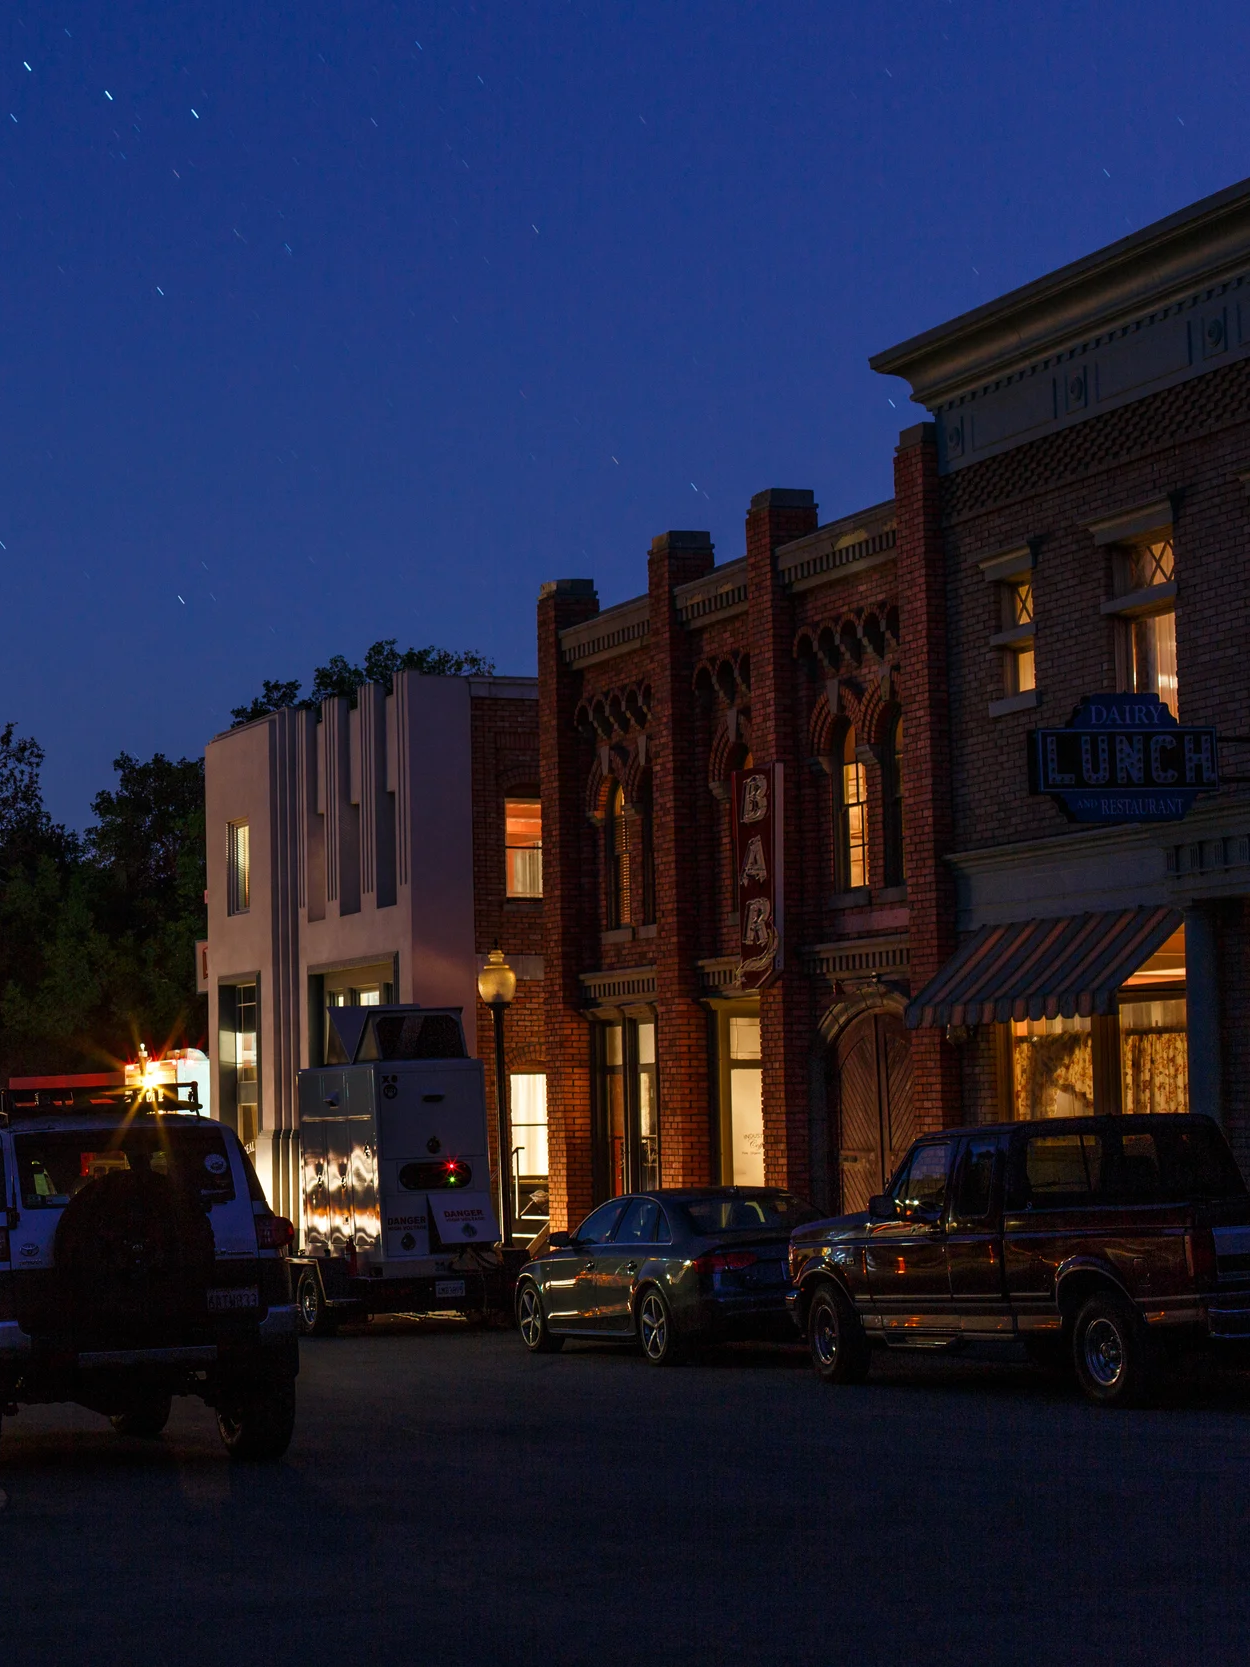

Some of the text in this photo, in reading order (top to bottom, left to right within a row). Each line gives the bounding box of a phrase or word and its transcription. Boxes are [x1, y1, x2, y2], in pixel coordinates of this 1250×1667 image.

[1090, 704, 1163, 724] DAIRY
[1047, 734, 1217, 784] LUNCH
[1077, 799, 1184, 815] AND RESTAURANT
[740, 773, 771, 947] BAR
[387, 1216, 426, 1225] DANGER
[444, 1209, 483, 1217] DANGER
